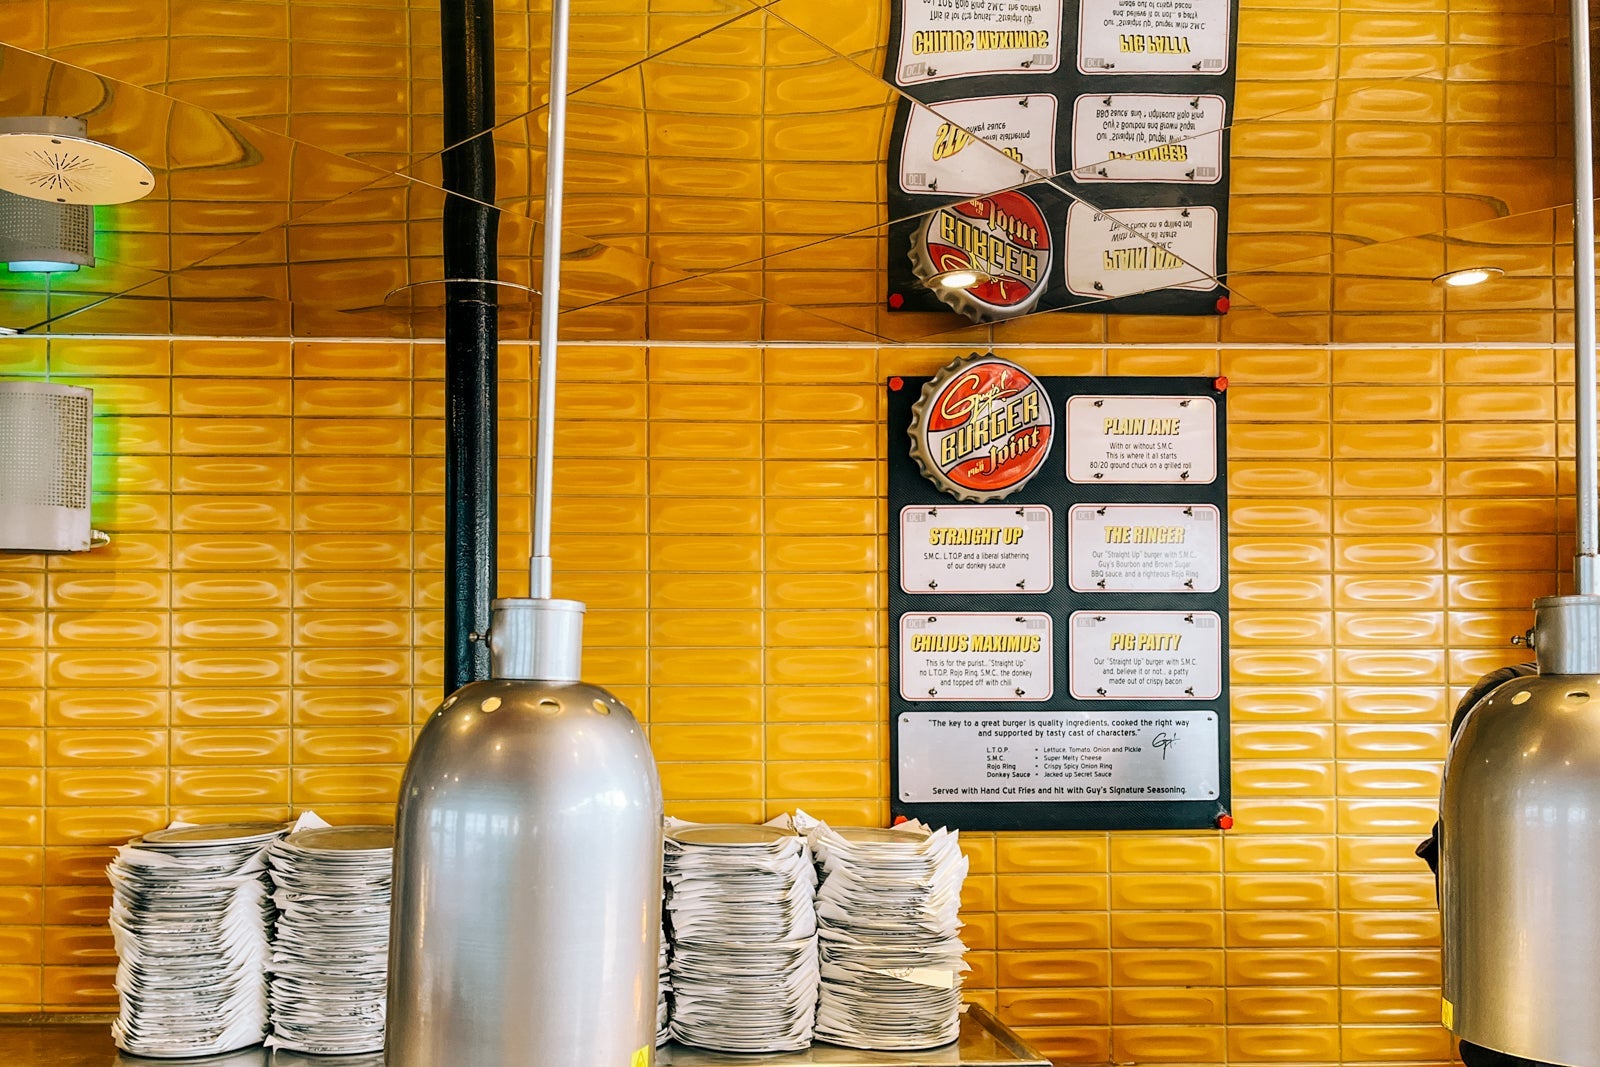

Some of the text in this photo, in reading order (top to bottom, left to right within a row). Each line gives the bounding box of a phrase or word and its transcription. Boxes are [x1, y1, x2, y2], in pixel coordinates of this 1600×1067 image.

[941, 390, 1039, 467] BURGER
[1104, 417, 1180, 435] PLAIN JANE
[983, 425, 1040, 475] Joint
[1090, 461, 1108, 469] 80/20
[1110, 461, 1129, 470] ground
[1131, 461, 1147, 469] chuck
[1164, 461, 1181, 470] grilled
[1183, 461, 1192, 469] roll
[929, 527, 1024, 545] STRAIGHT UP
[1104, 526, 1185, 544] THE RINGER
[1000, 553, 1029, 561] slathering
[1144, 551, 1162, 559] burger
[1098, 561, 1114, 569] Guy's
[1174, 561, 1191, 569] Sugar
[1142, 570, 1169, 578] righteous
[1186, 570, 1199, 578] Ring
[911, 634, 1041, 653] CHILIUS MAXIMUS
[1110, 633, 1182, 651] PIG PATTY
[1146, 658, 1164, 666] burger
[950, 669, 963, 678] Rojo
[1012, 669, 1032, 678] donkey
[1174, 668, 1189, 676] patty
[953, 679, 973, 687] topped
[1146, 678, 1163, 686] crispy
[949, 720, 961, 728] key
[981, 720, 1000, 728] great
[1003, 720, 1026, 728] burger
[1038, 720, 1063, 728] quality
[1155, 720, 1172, 728] right
[995, 729, 1032, 738] supported
[1035, 729, 1044, 738] by
[1047, 729, 1066, 738] tasty
[1086, 787, 1107, 795] Guy's
[1110, 787, 1144, 795] Signature
